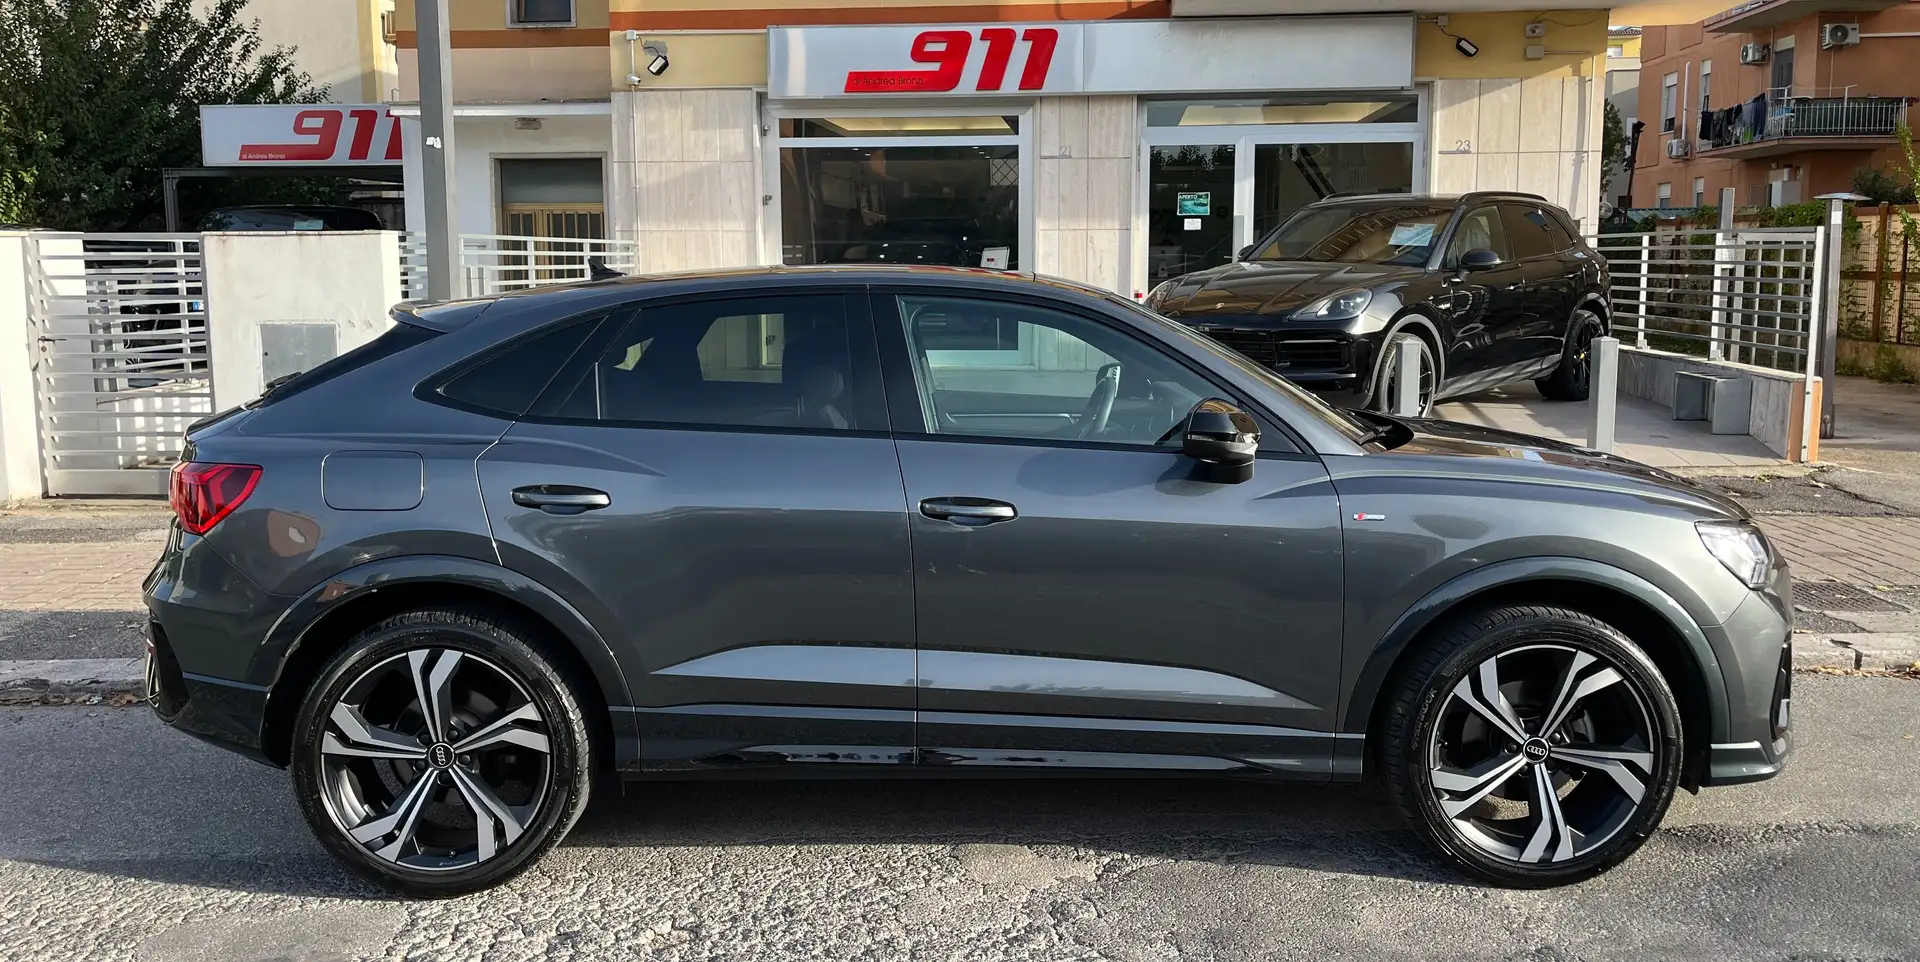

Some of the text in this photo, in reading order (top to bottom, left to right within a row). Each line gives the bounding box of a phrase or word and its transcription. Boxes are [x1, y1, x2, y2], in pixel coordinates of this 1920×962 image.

[844, 28, 1059, 92] 911
[863, 76, 896, 85] Andrea
[899, 76, 924, 85] Bronzi
[1059, 145, 1072, 157] 21
[1455, 139, 1471, 152] 23
